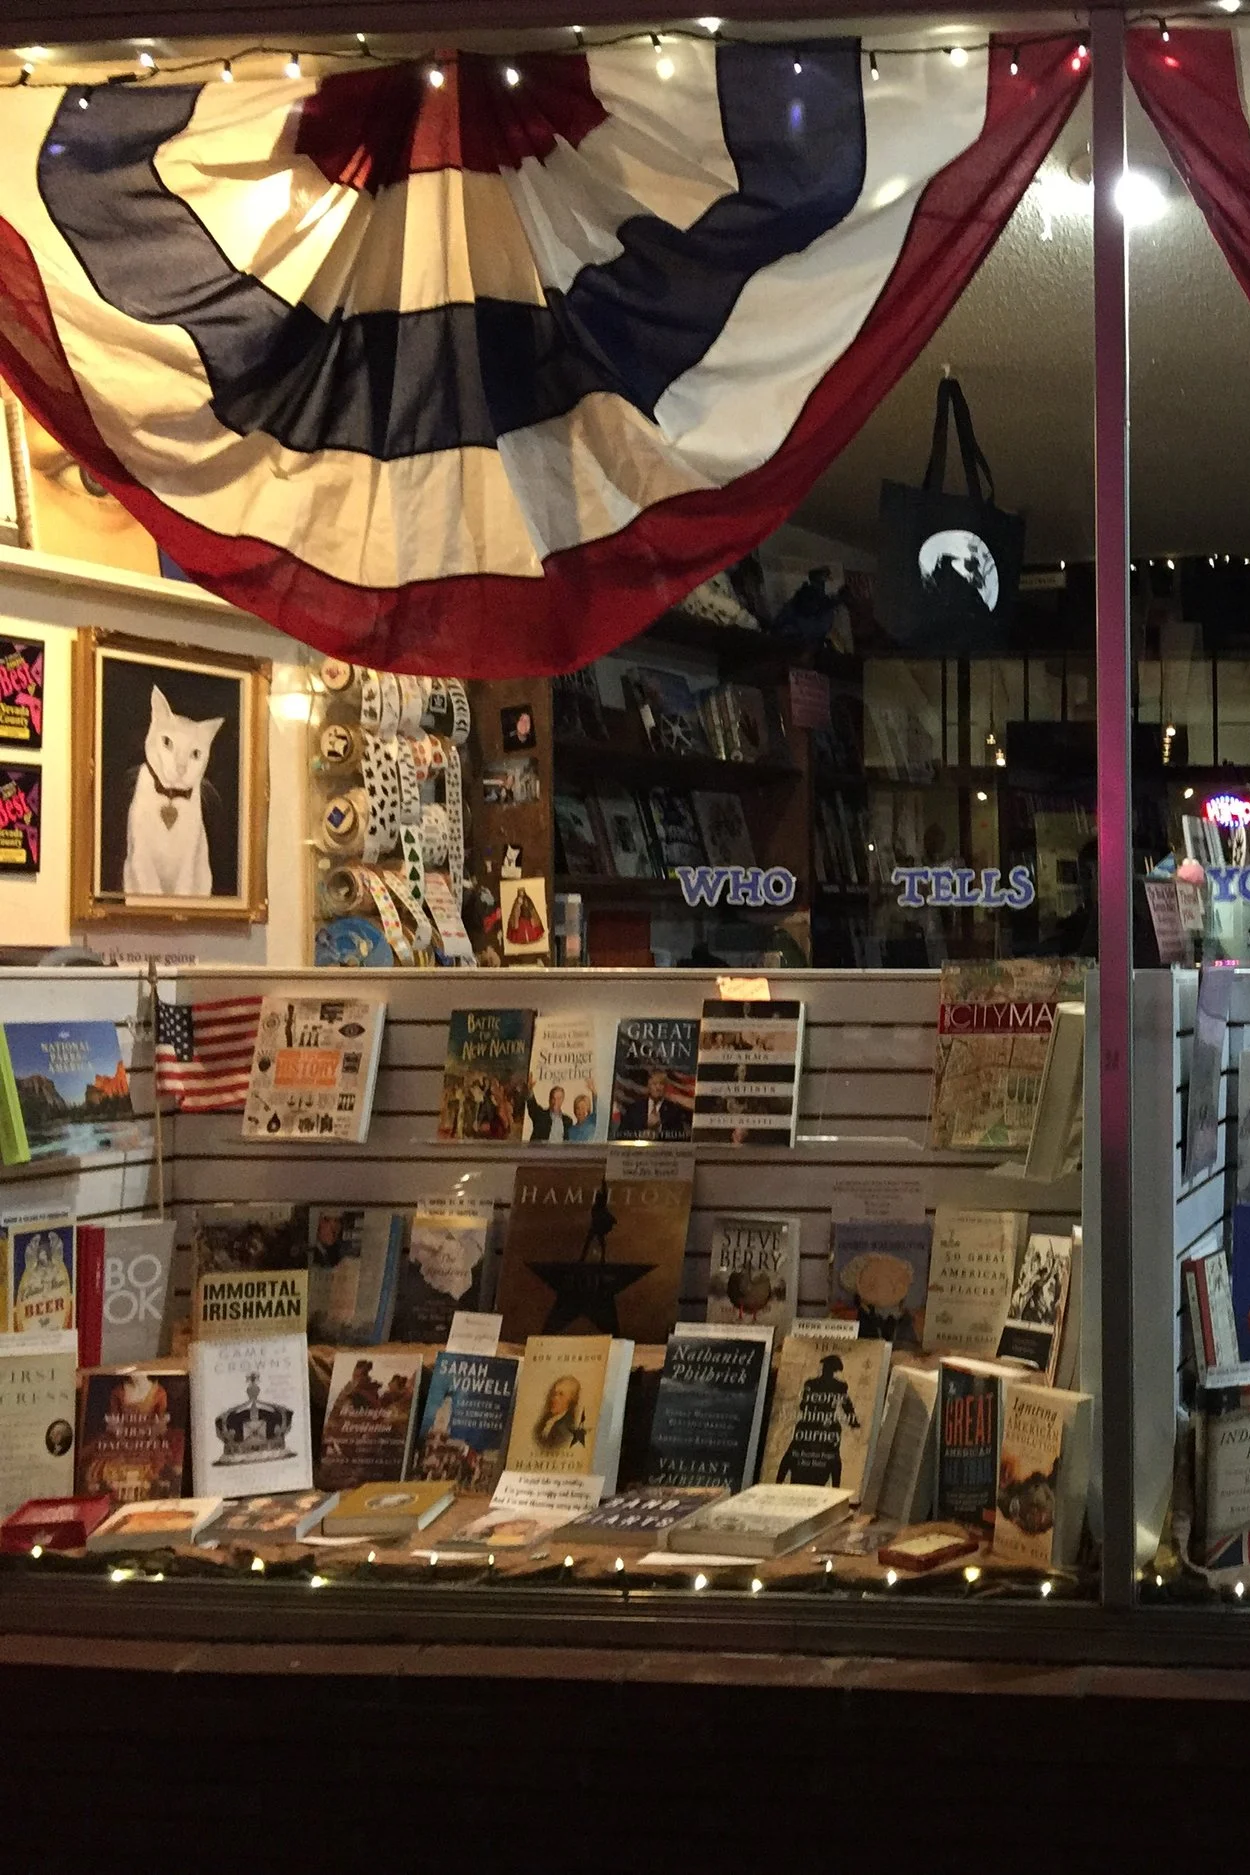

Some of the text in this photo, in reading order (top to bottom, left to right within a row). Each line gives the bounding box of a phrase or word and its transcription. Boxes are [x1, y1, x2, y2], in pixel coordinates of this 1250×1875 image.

[676, 866, 797, 907] WHO
[891, 866, 1036, 907] TELLS
[627, 1021, 695, 1041] GREAT
[539, 1050, 593, 1068] Stronger
[626, 1041, 693, 1059] AGAIN
[538, 1067, 593, 1085] Together
[519, 1185, 685, 1205] HAMILTON
[721, 1228, 783, 1251] STEVE
[720, 1248, 784, 1272] BERRY
[940, 1267, 1007, 1280] AMERICAN
[203, 1279, 301, 1301] IMMORTAL
[25, 1297, 65, 1319] BEER
[203, 1300, 302, 1322] IRISHMAN
[672, 1345, 756, 1367] Nathaniel
[10, 1367, 60, 1384] IRST
[440, 1359, 490, 1378] SARAH
[671, 1363, 748, 1386] Philbrick
[450, 1375, 511, 1397] VOWELL
[945, 1392, 995, 1446] GREAT
[1013, 1397, 1059, 1424] Igniting
[116, 1427, 153, 1438] FIRST
[97, 1439, 171, 1450] DAUGHTER
[514, 1459, 585, 1472] HAMILTON
[659, 1457, 732, 1475] VALIANT
